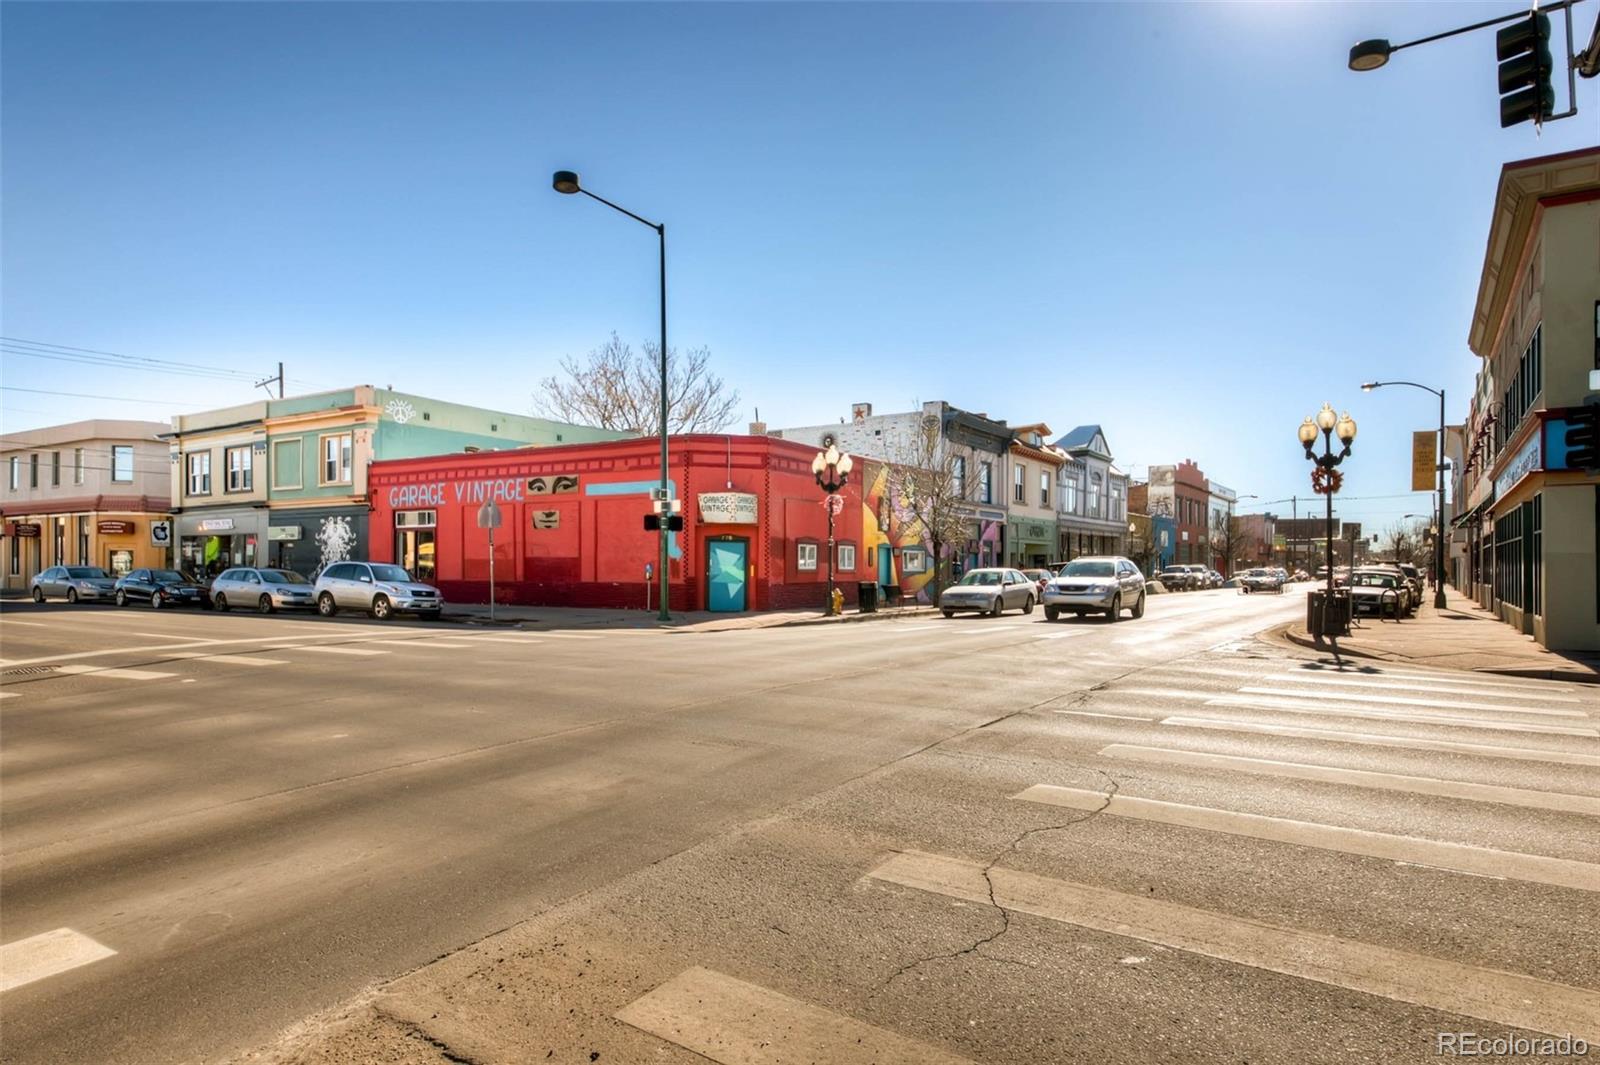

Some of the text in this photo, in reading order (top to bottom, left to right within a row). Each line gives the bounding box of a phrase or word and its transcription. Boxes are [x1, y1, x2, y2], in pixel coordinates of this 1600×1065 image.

[389, 478, 524, 507] GARAGE VINTAGE
[703, 496, 729, 504] GARAGE
[701, 504, 730, 512] VINTAGE
